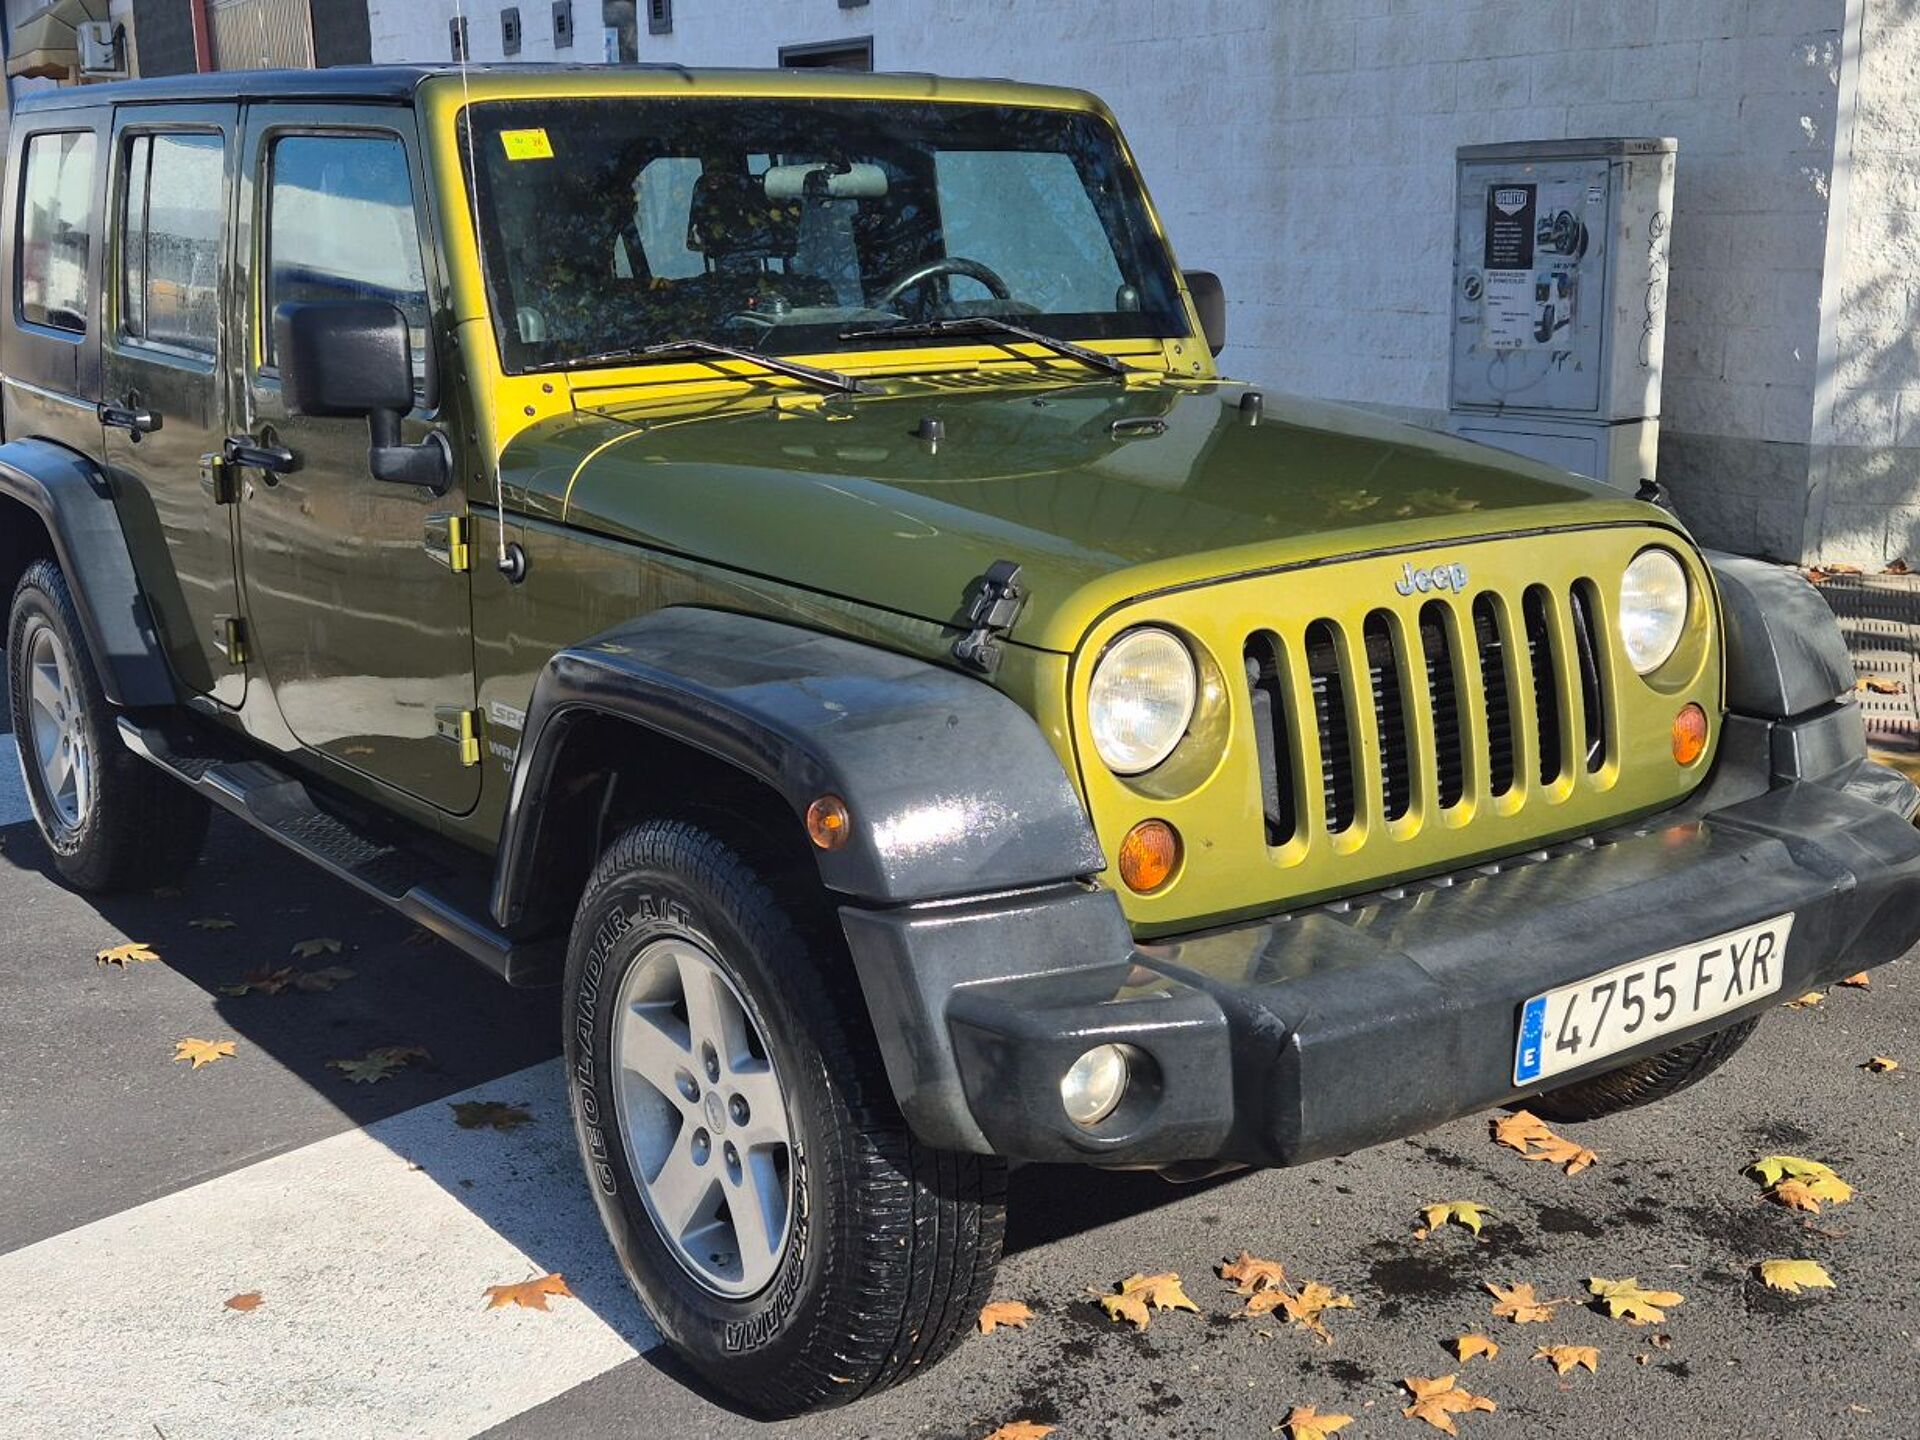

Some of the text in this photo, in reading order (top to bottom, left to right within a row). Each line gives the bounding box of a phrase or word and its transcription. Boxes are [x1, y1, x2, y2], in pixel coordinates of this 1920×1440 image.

[1395, 562, 1469, 596] Jeep
[1556, 931, 1775, 1055] 4755 FXR
[576, 905, 631, 1196] GEOLANDAR
[1524, 1047, 1537, 1067] E
